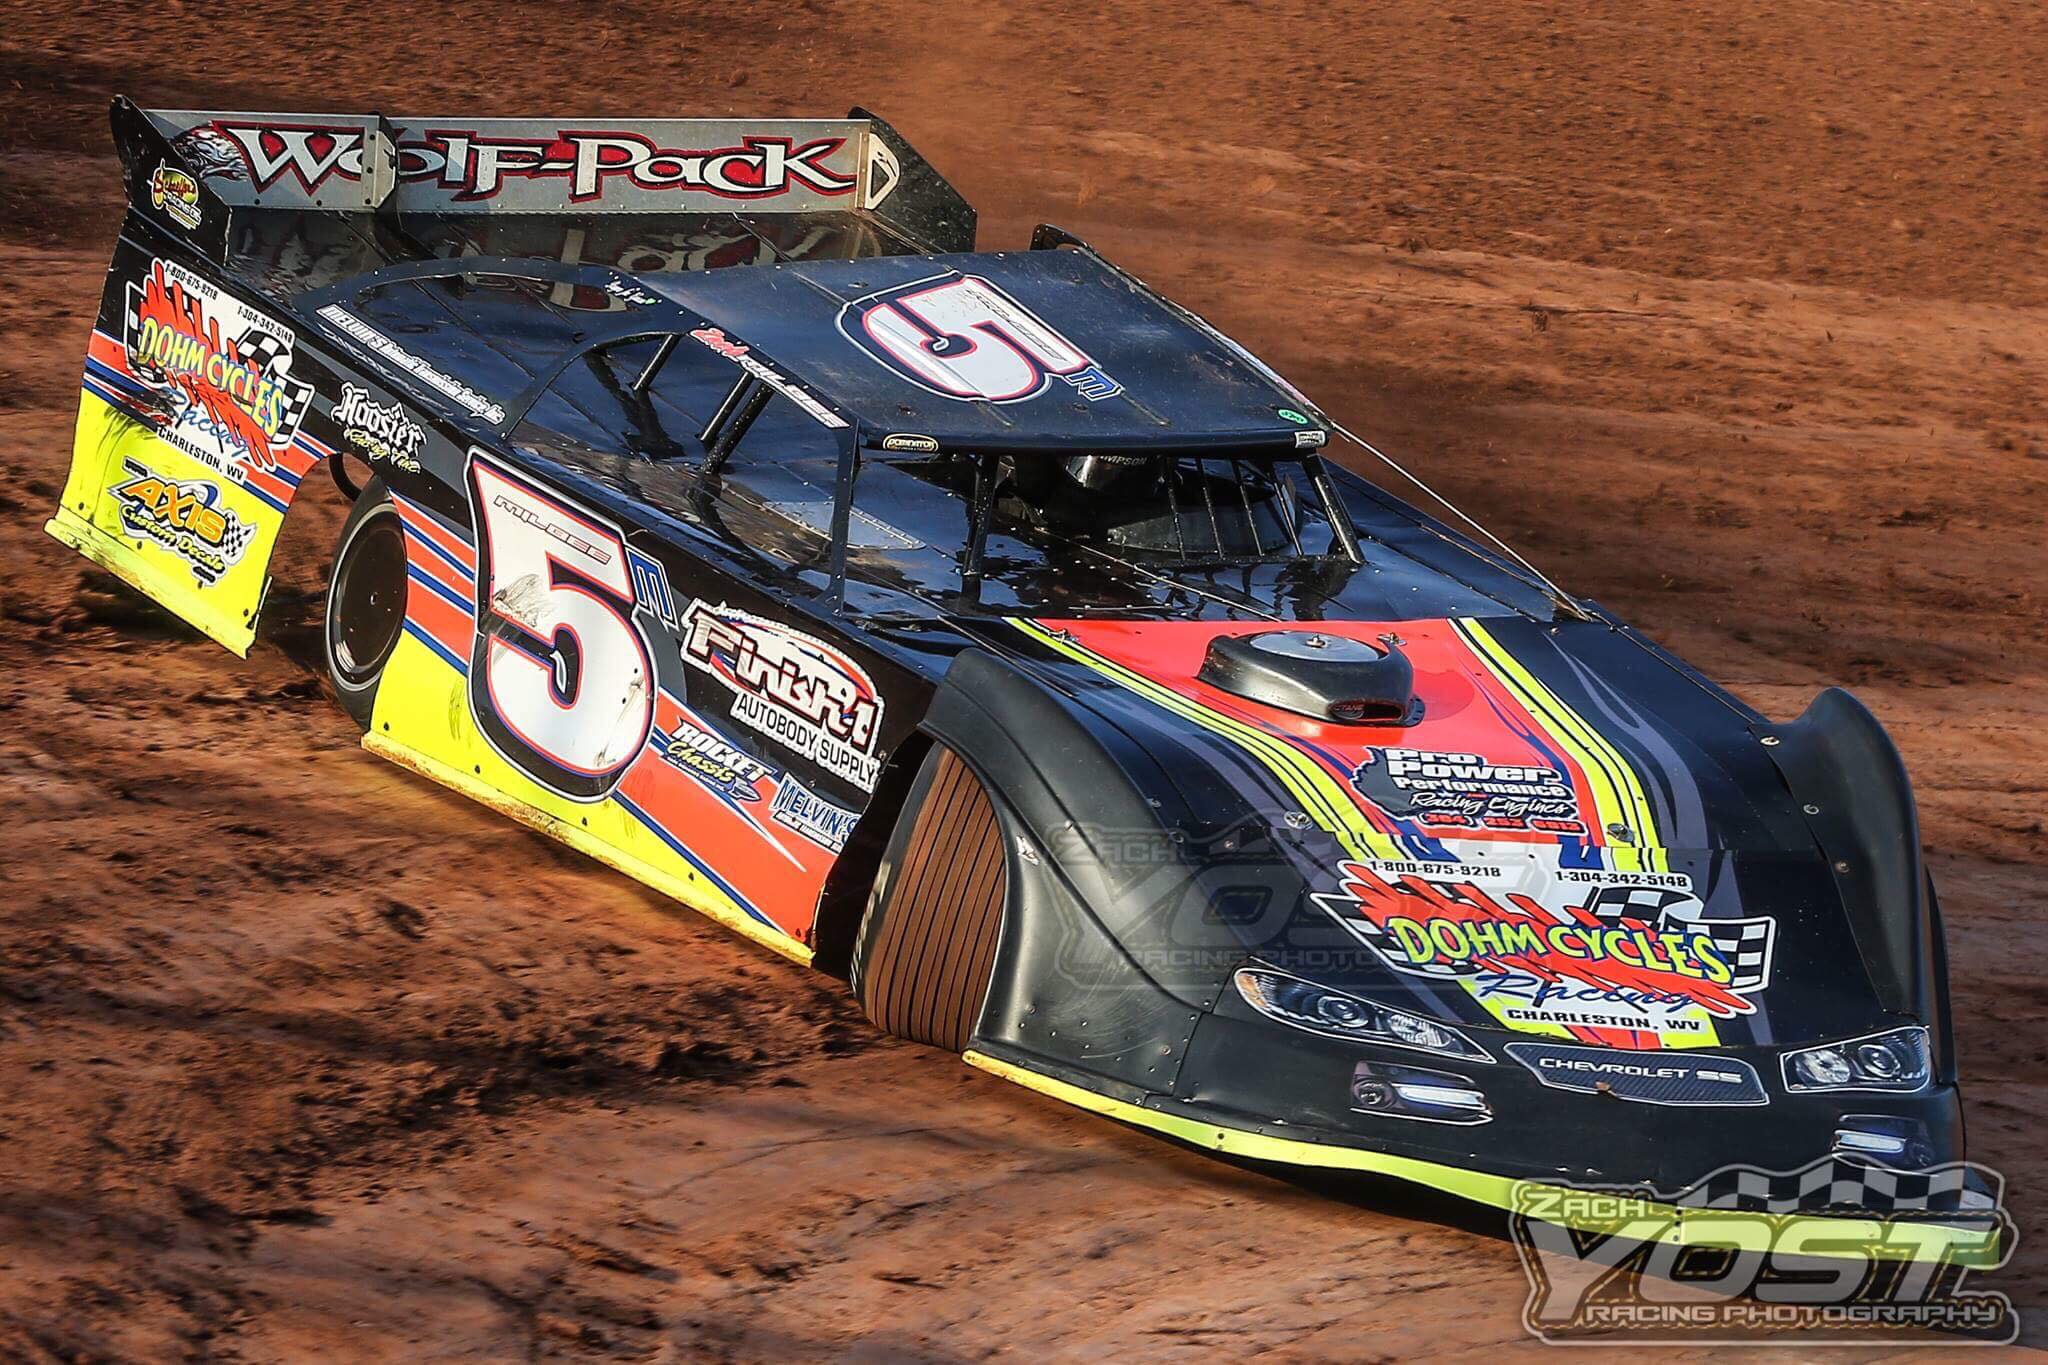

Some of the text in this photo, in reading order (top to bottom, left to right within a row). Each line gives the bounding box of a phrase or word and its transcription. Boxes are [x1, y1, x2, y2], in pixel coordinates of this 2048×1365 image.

[165, 262, 294, 344] 1-800-675-9218 1-304-342-5148
[140, 315, 285, 438] DOHM CYCLES
[333, 384, 423, 454] Hoosier
[226, 464, 244, 480] WV
[119, 478, 227, 546] AXIS
[121, 504, 226, 573] Custom Decals
[669, 719, 774, 783] ROCKET
[736, 692, 876, 788] AUTOBODY SUPPLY
[1385, 748, 1478, 765] Pro
[667, 740, 736, 783] Chassis
[1387, 759, 1553, 783] Power
[1391, 775, 1568, 798] Performance
[1410, 792, 1572, 818] Racing Engines
[1369, 860, 1688, 888] 1-800-675-9218 1-304-342-5148
[1386, 917, 1736, 985] DOHM CYCLES
[1475, 973, 1696, 1013] Racing
[1665, 1019, 1701, 1031] WV
[1539, 1057, 1743, 1083] CHEVROLET SS
